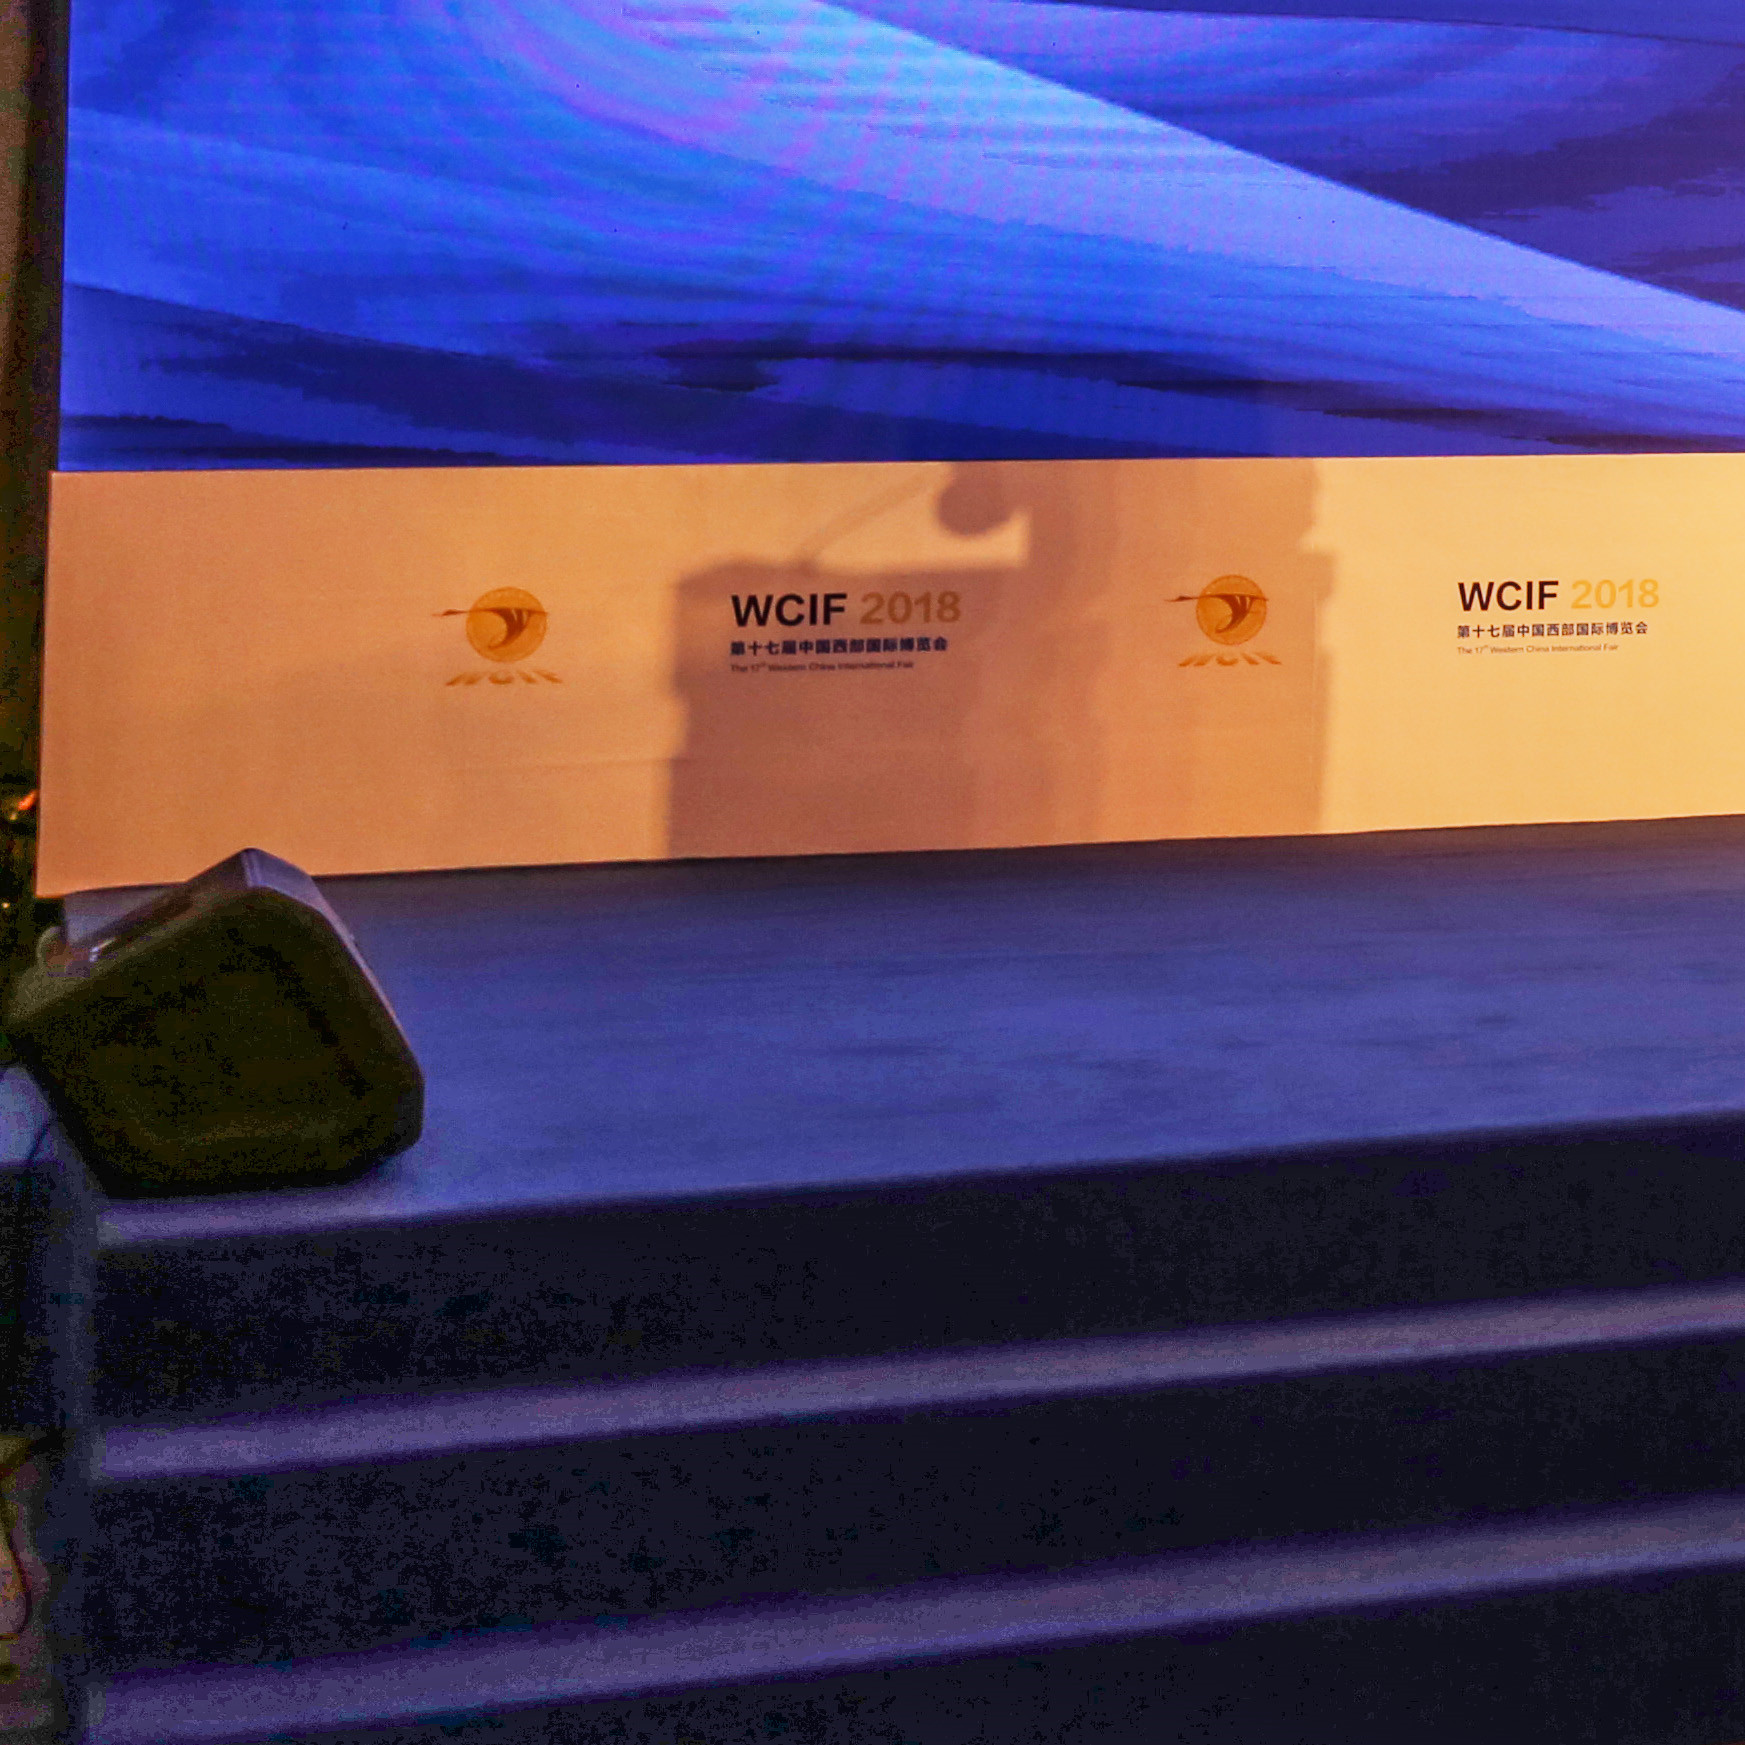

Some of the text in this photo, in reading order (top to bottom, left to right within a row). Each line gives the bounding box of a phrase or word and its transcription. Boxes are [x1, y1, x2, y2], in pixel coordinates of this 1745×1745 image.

[1458, 578, 1660, 612] WCIF 2018
[731, 590, 962, 627] WCIF 2018
[1457, 621, 1648, 639] 第十七届中国西部国际博览会
[1526, 644, 1550, 653] China
[1603, 643, 1619, 651] Fair
